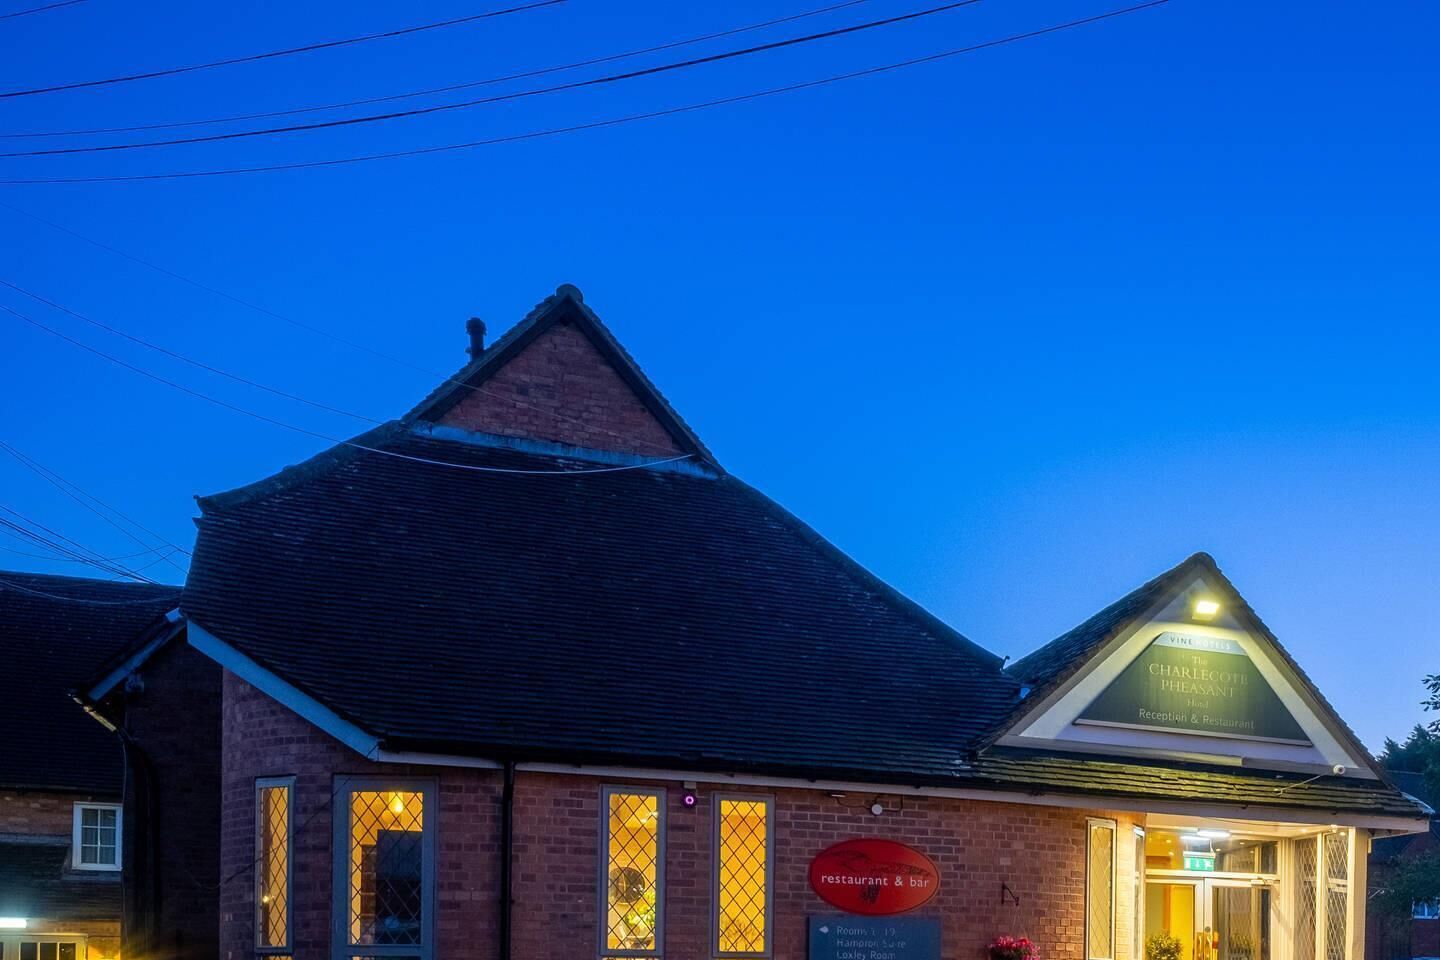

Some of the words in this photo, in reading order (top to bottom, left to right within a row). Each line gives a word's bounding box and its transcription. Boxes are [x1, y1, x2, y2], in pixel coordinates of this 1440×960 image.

[1170, 636, 1193, 645] VINE
[1191, 656, 1208, 665] The
[1149, 663, 1249, 685] CHARLECOTE
[1160, 679, 1234, 698] PHEASANT
[1138, 708, 1187, 723] Reception
[1190, 714, 1200, 724] &
[1202, 714, 1256, 730] Restaurant
[821, 874, 889, 886] restaurant
[894, 875, 904, 886] &
[910, 875, 930, 888] bar
[836, 951, 867, 960] Loxley
[870, 951, 896, 960] Room
